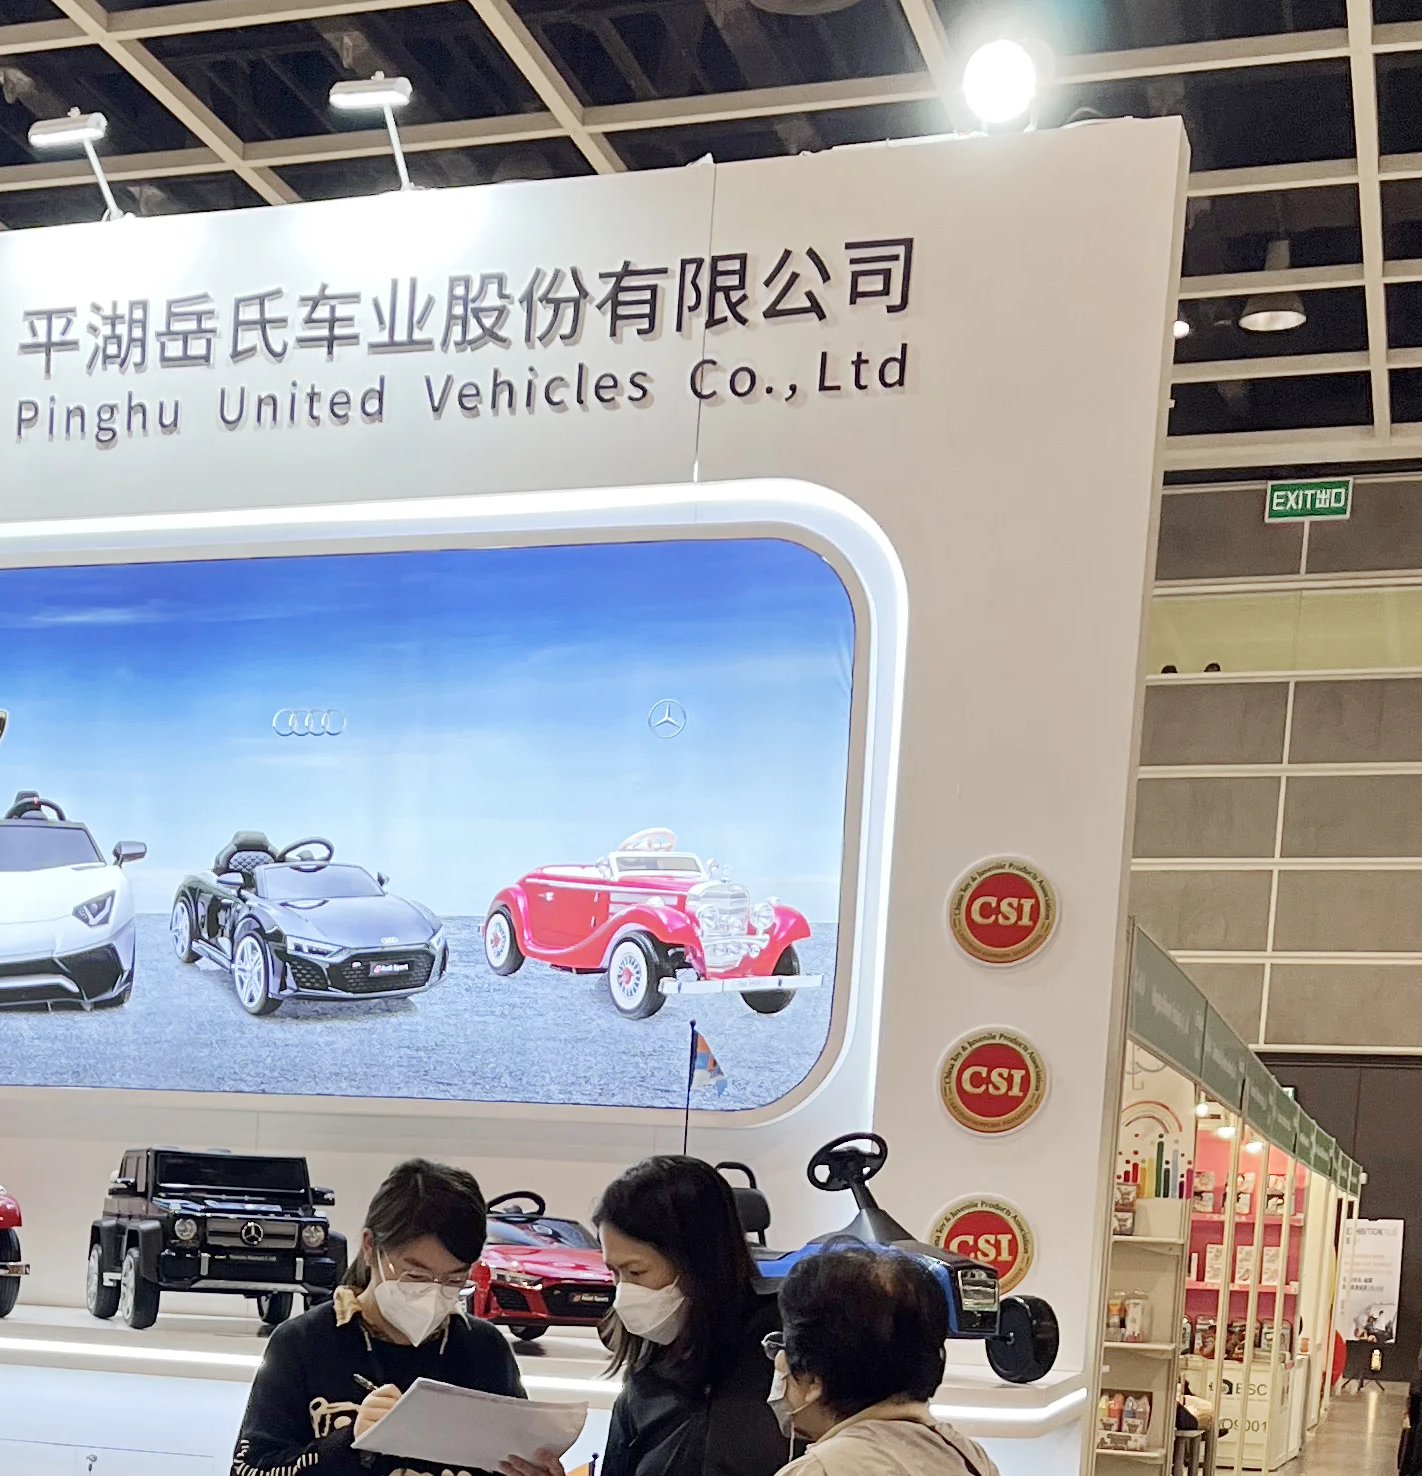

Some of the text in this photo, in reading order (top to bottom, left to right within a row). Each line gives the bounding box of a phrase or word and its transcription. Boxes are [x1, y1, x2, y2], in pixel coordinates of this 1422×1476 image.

[17, 236, 915, 380] 平湖岳氏车业股份有限公司
[15, 391, 181, 450] Pinghu
[219, 375, 385, 432] United
[424, 362, 650, 419] Vehicles
[970, 896, 1036, 927] CSI
[961, 1065, 1026, 1097] CSI
[949, 1234, 1012, 1262] CSI
